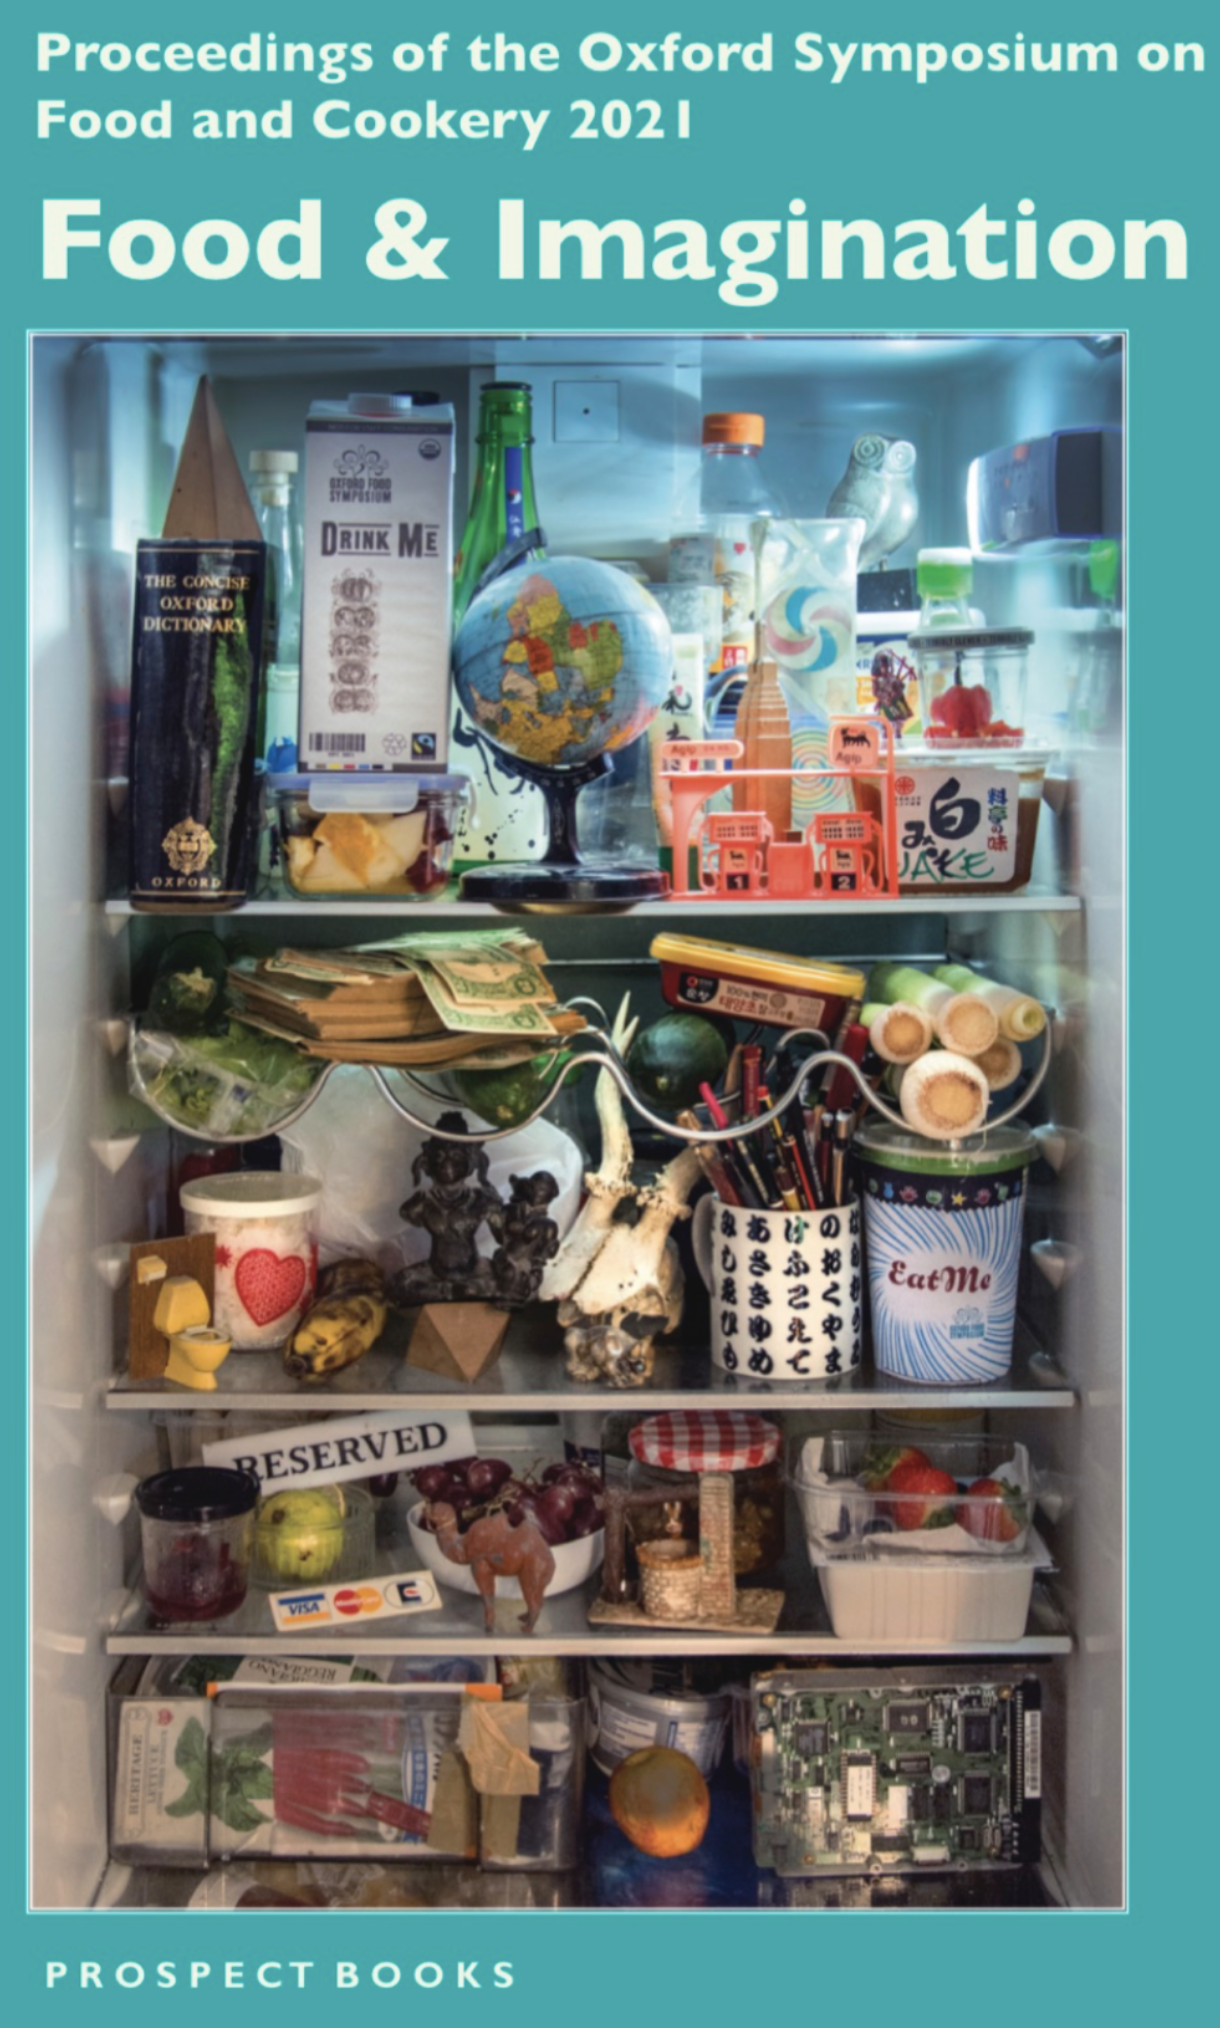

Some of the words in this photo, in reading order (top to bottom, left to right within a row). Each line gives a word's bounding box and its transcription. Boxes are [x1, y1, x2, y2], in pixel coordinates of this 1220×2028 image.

[330, 478, 365, 489] OXFORD
[368, 478, 392, 489] FOOD
[330, 490, 392, 503] SYMPOSIUM
[144, 574, 176, 588] THE
[183, 575, 250, 590] CONCISE
[160, 596, 234, 611] OXFORD
[143, 616, 246, 633] DICTIONARY
[835, 752, 862, 764] Agip
[987, 788, 1008, 852] 料亭の味
[151, 877, 222, 889] OXFORD
[733, 876, 743, 888] 1
[838, 876, 850, 888] 2
[233, 1421, 448, 1482] RESERVED
[288, 1601, 320, 1616] VISA
[129, 1734, 142, 1815] HERITAGE
[147, 1744, 160, 1804] LETTUCE
